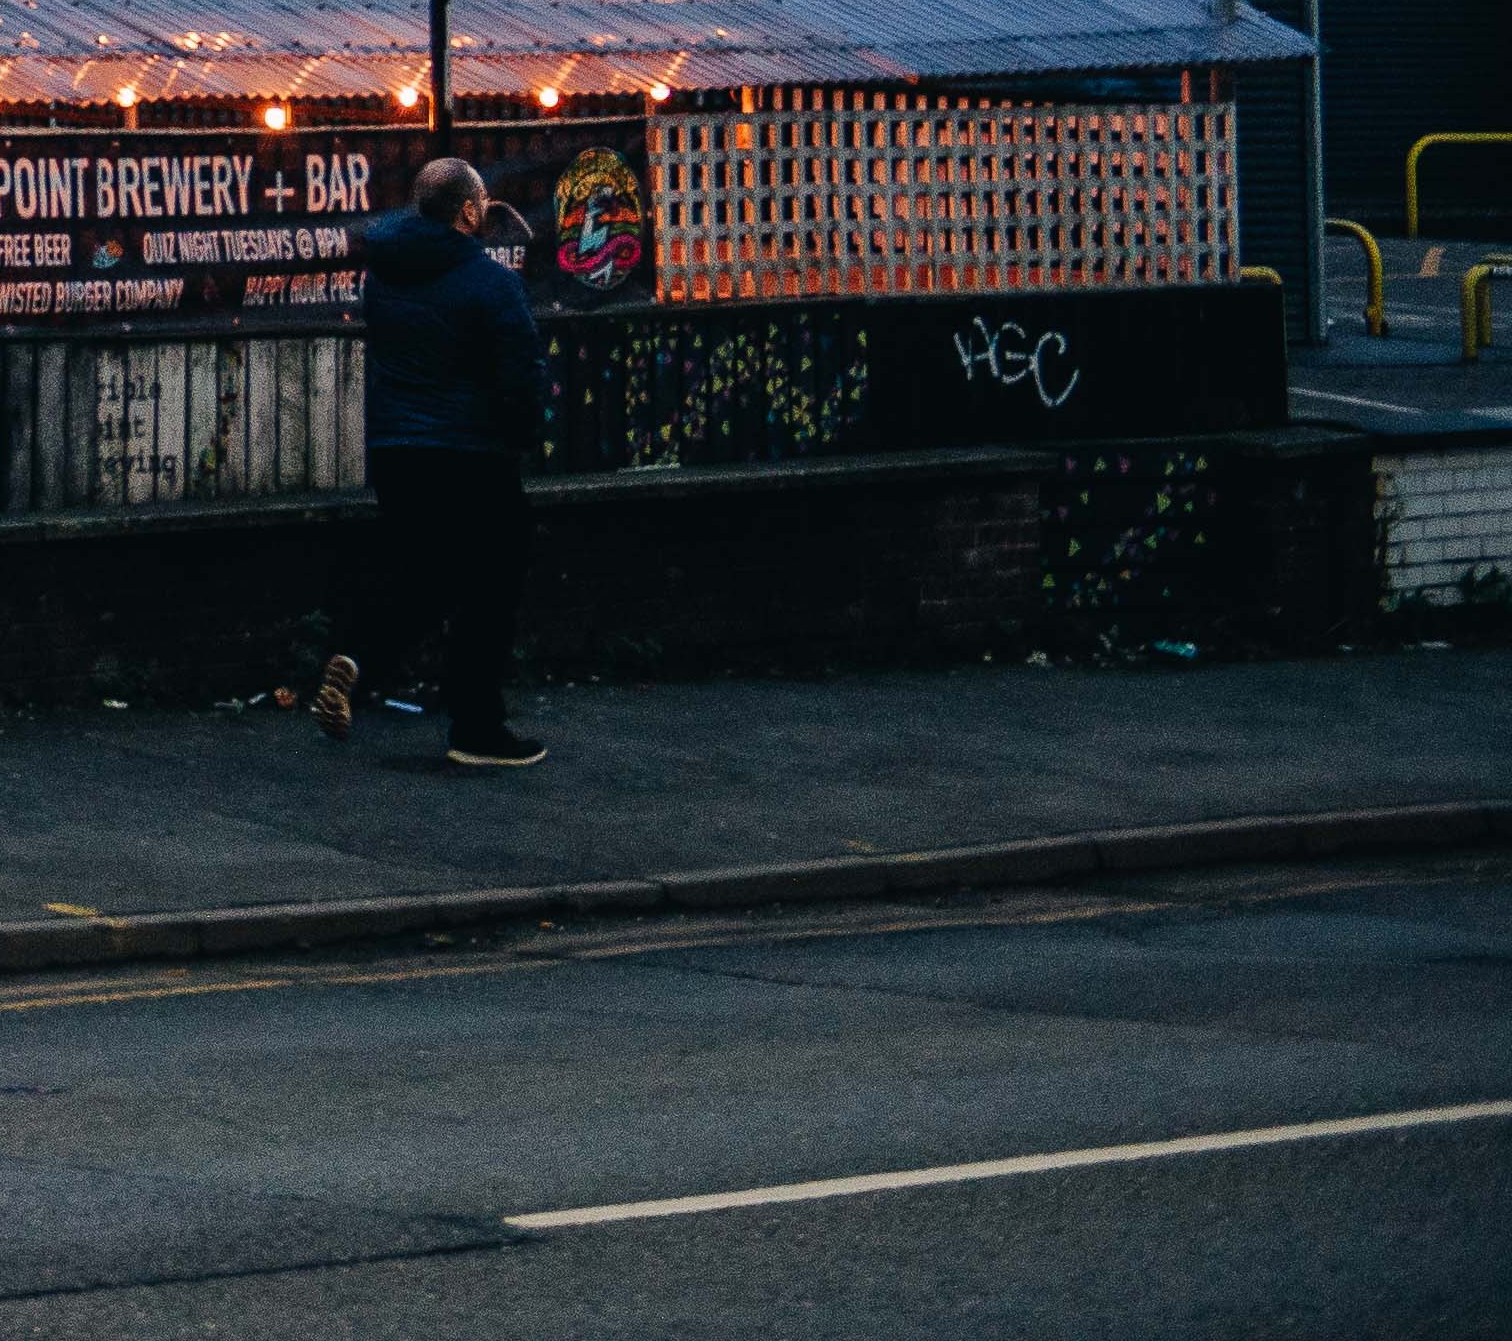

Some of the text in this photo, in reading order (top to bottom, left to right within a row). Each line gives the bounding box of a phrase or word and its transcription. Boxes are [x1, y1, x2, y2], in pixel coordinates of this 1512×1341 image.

[96, 155, 253, 219] BREWERY
[305, 153, 370, 214] BAR
[33, 233, 72, 266] BEER
[143, 231, 176, 264] QUIZ
[177, 230, 220, 263] NIGHT
[221, 229, 294, 261] TUESDAYS
[53, 280, 114, 313] BURGER
[114, 278, 185, 312] COMPANY
